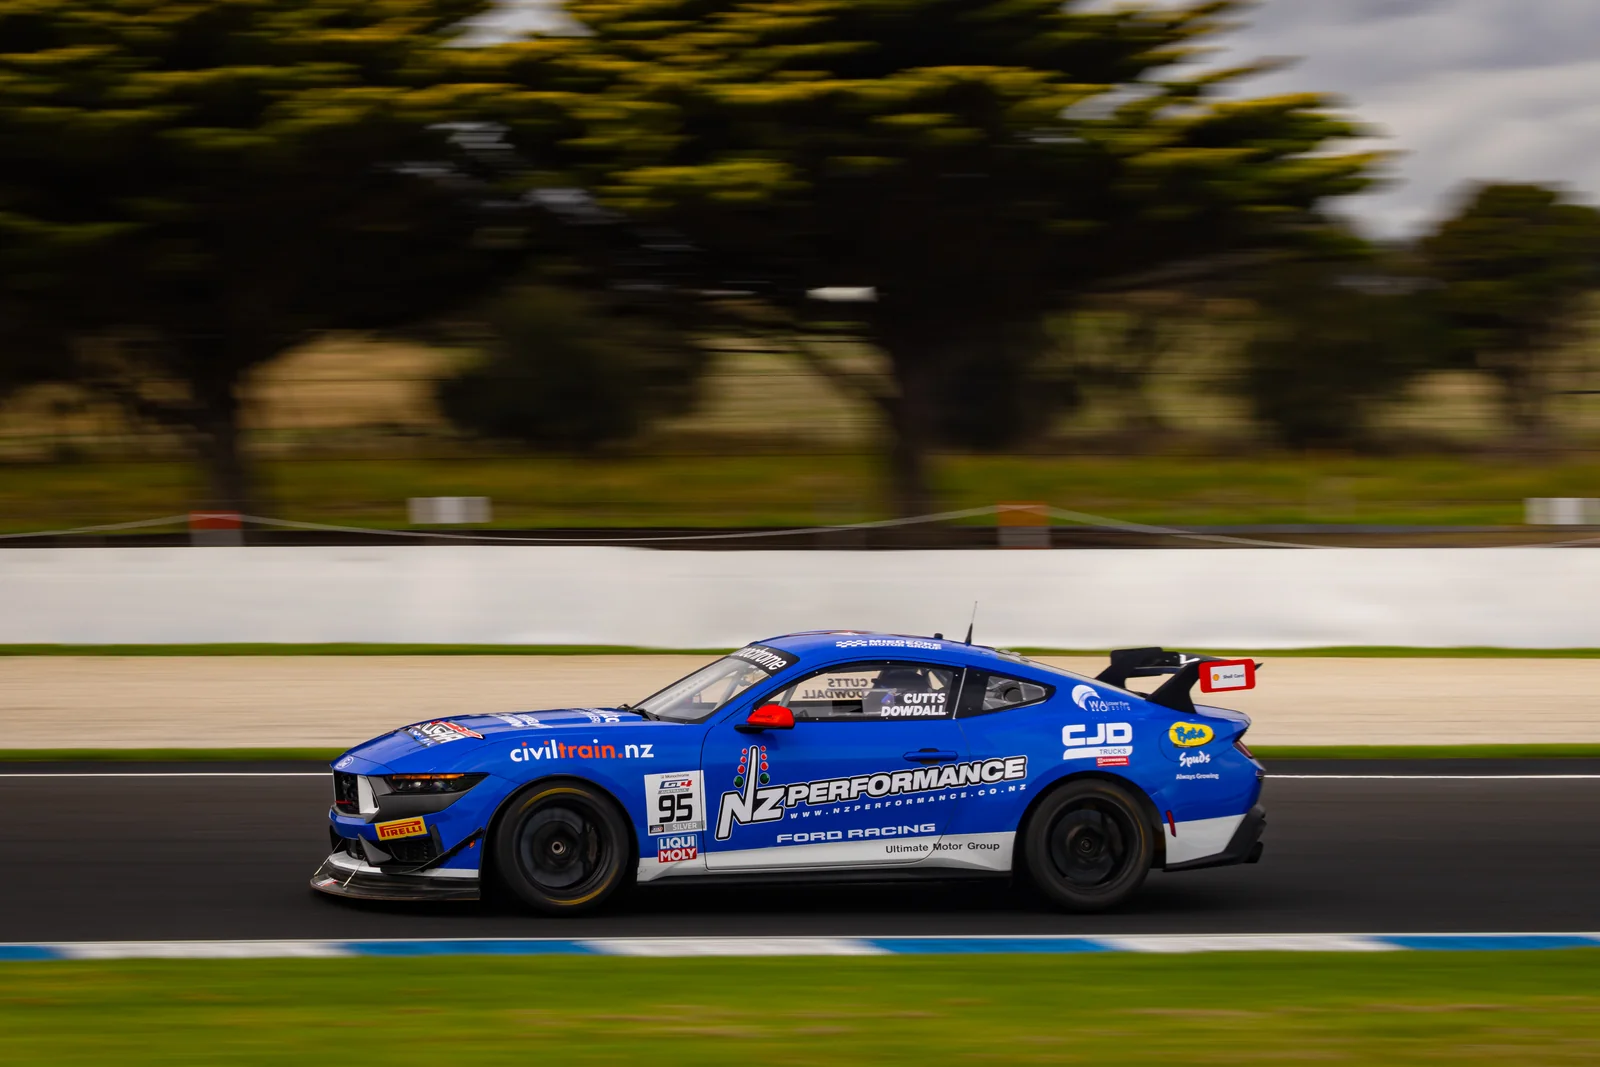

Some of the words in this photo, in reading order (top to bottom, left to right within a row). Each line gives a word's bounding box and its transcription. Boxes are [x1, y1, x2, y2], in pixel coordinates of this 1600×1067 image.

[903, 693, 946, 704] CUTTS
[880, 705, 947, 717] DOWDALL
[1062, 722, 1133, 746] CJD
[510, 739, 655, 762] civiltrain.nz
[1179, 750, 1211, 768] Spuds
[658, 793, 693, 823] 95
[379, 820, 422, 838] PIRELLI
[672, 822, 697, 831] SILVER
[777, 830, 842, 844] FORD
[848, 823, 936, 839] RACING
[660, 835, 695, 849] LIQUI
[885, 843, 929, 854] Ultimate
[932, 842, 963, 851] Motor
[967, 841, 1001, 852] Group
[660, 848, 696, 861] MOLY
